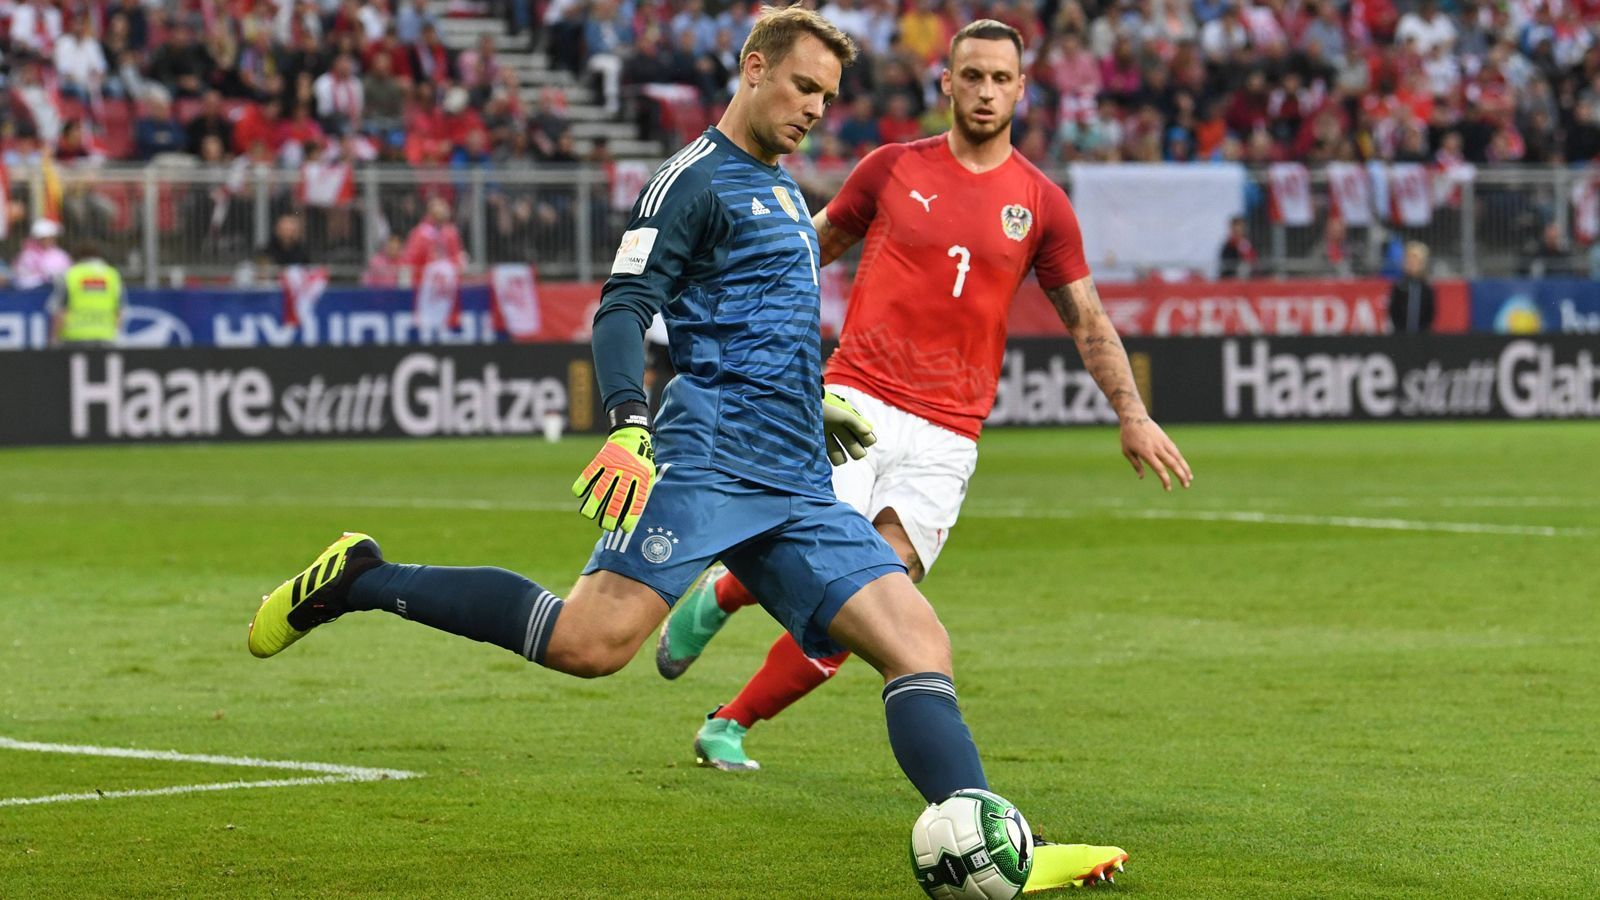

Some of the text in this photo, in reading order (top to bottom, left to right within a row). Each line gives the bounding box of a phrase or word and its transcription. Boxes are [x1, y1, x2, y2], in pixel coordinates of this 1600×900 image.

[947, 244, 970, 298] 7
[1152, 295, 1394, 336] GENERA
[70, 353, 273, 438] Haare
[276, 374, 388, 434] statt
[391, 353, 567, 436] Glatze
[983, 350, 1121, 425] latz
[1222, 339, 1600, 418] Haare statt Glat
